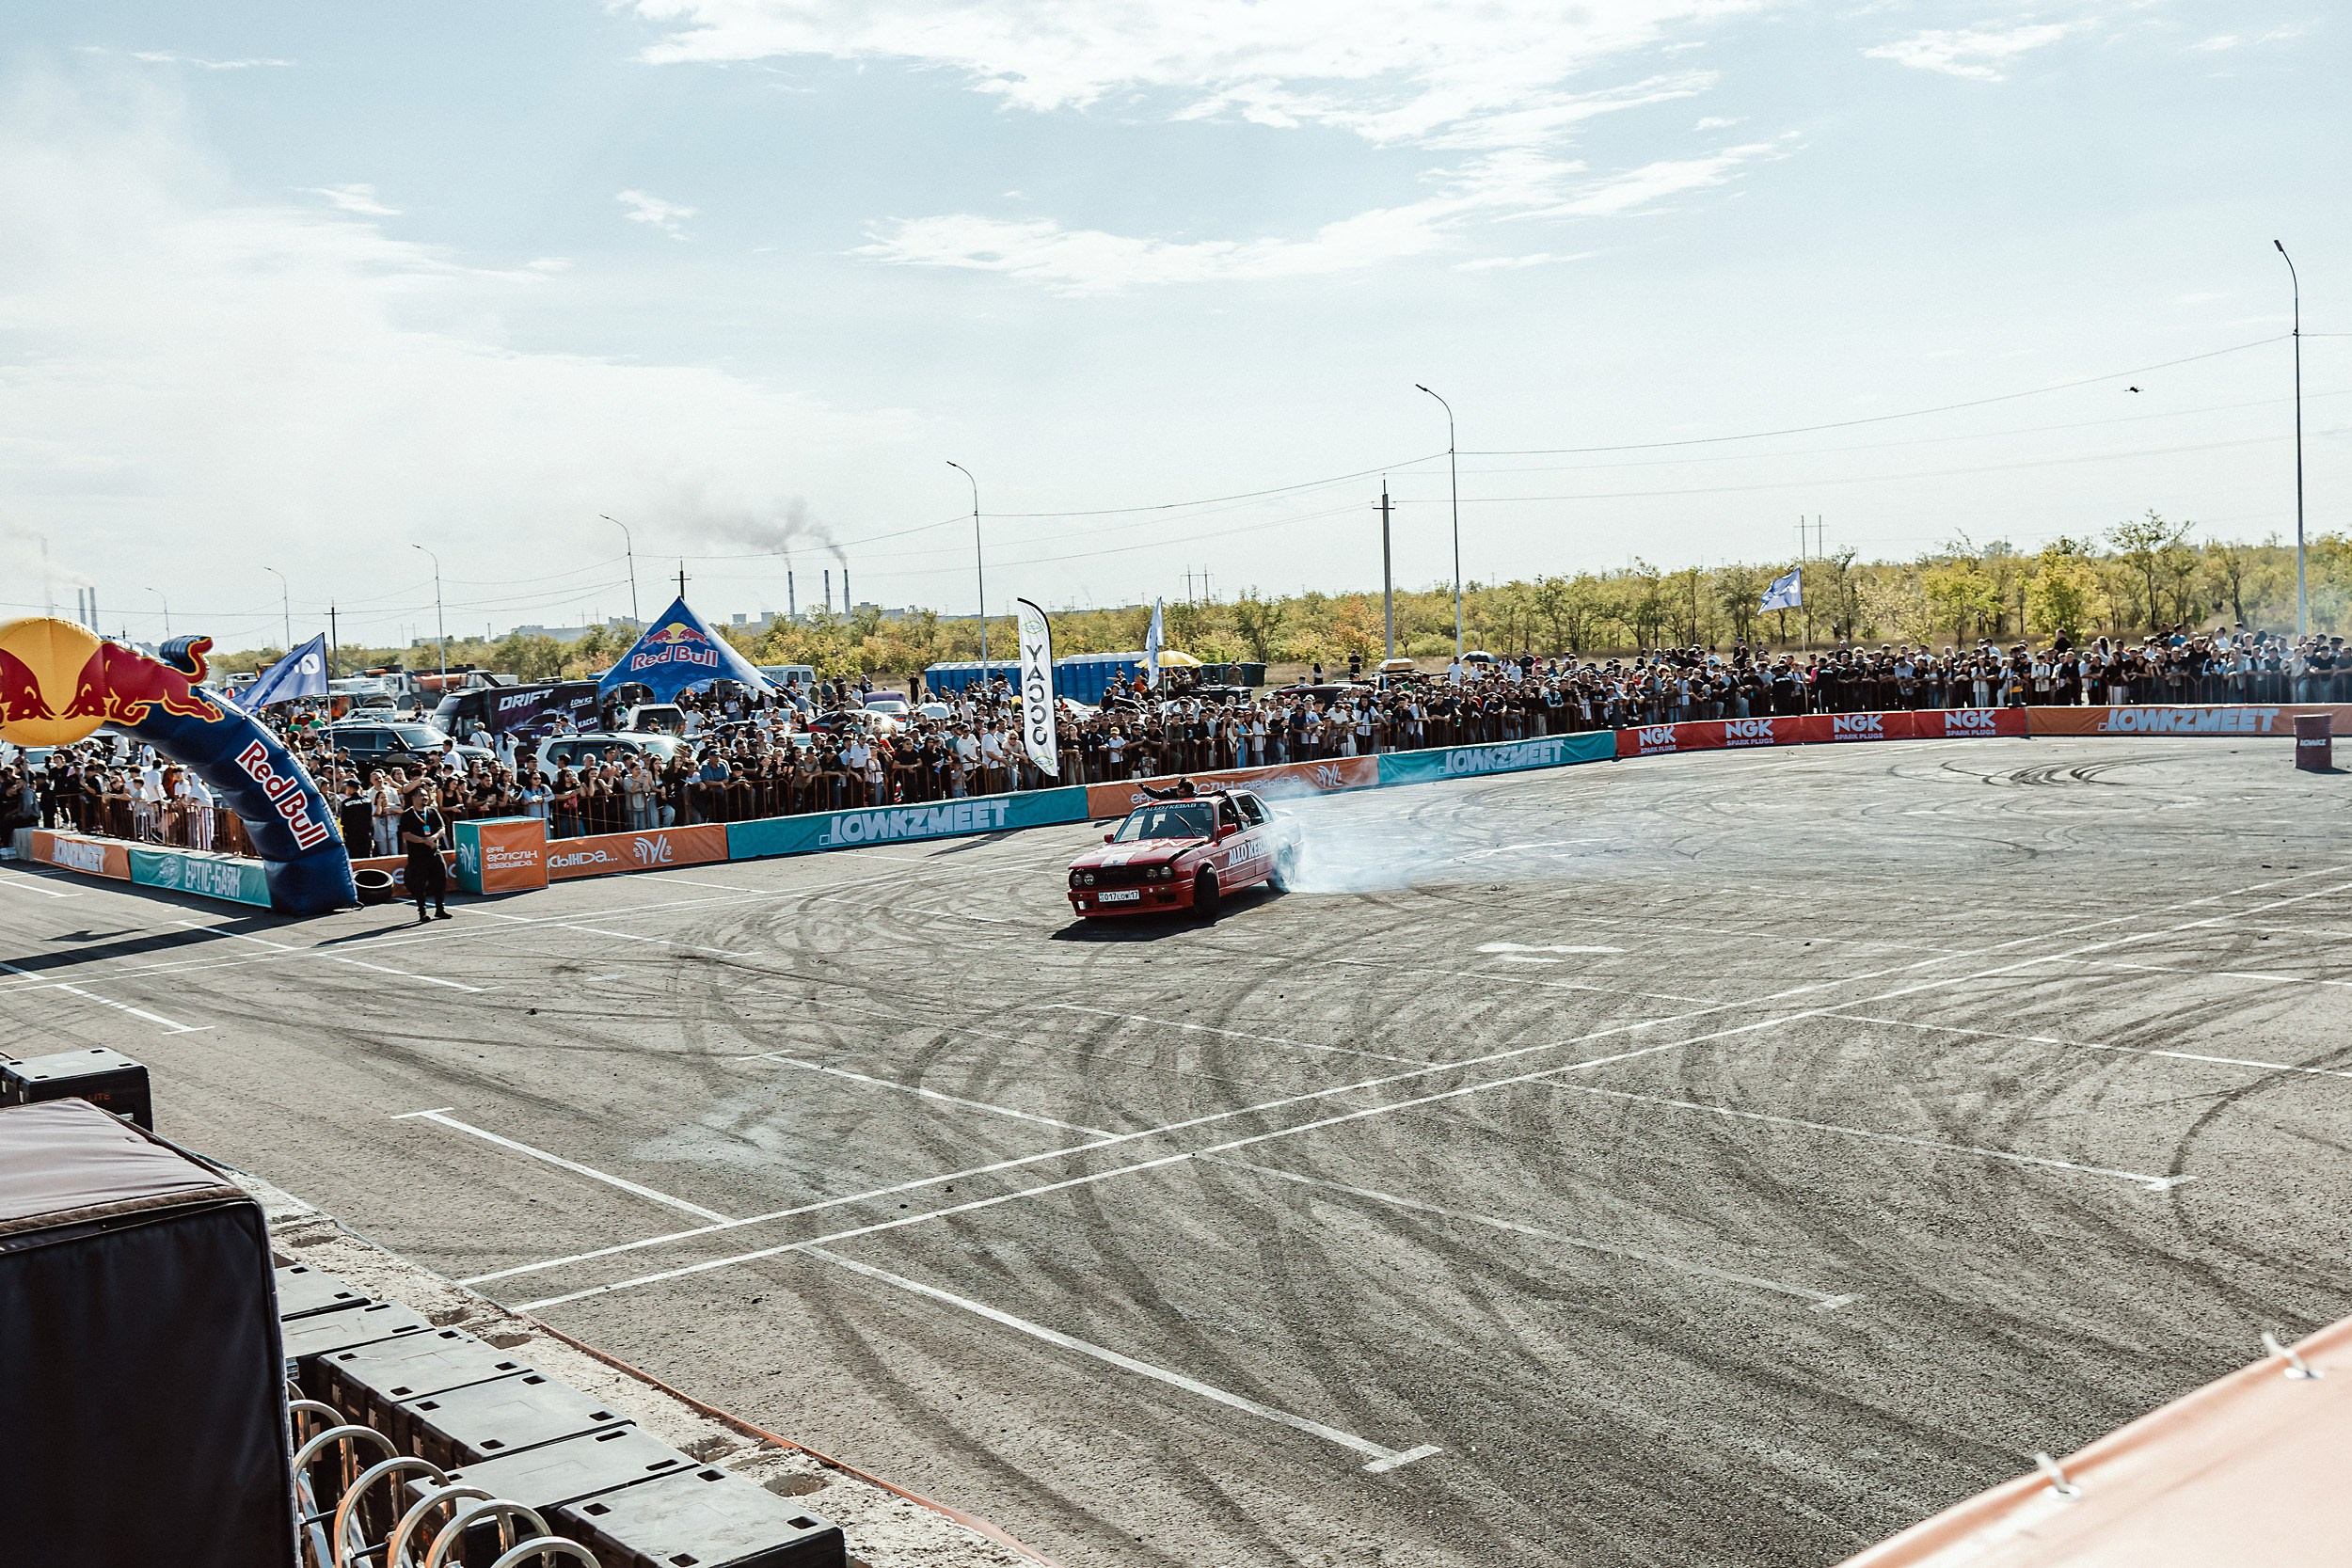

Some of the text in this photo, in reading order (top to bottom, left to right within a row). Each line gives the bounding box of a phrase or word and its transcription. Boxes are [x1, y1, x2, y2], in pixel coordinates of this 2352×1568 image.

[630, 645, 718, 672] Red Bull
[499, 689, 554, 711] DRIFT
[1725, 719, 1774, 739] NGK
[1834, 714, 1883, 733] NGK
[1945, 710, 1996, 729] NGK
[1639, 725, 1677, 746] NGK
[235, 738, 298, 801] Red
[276, 789, 330, 850] Bull
[1229, 844, 1248, 866] ALLO
